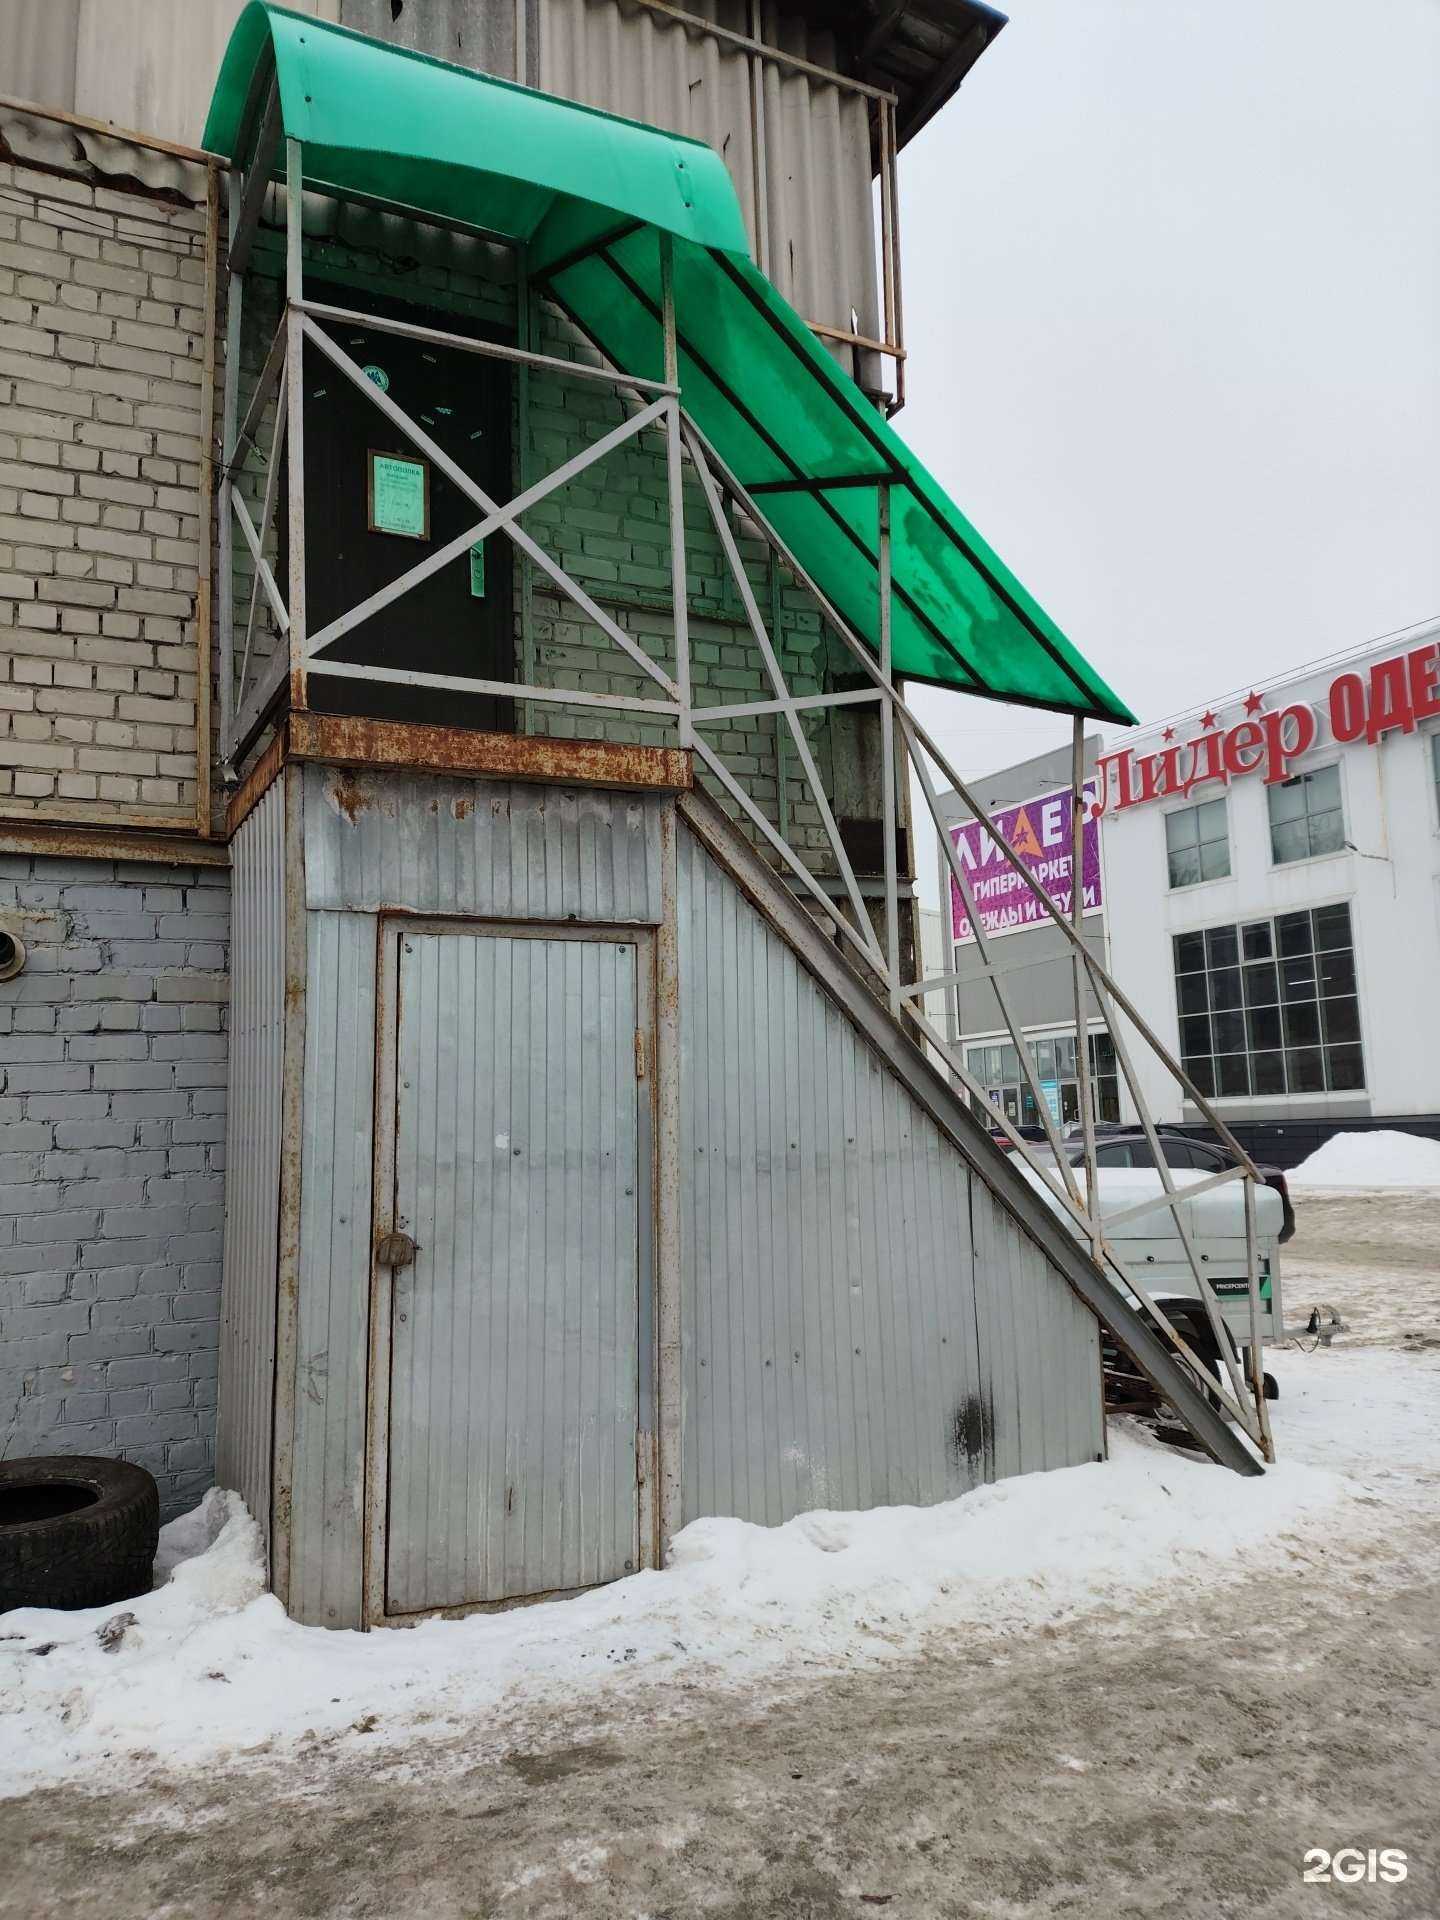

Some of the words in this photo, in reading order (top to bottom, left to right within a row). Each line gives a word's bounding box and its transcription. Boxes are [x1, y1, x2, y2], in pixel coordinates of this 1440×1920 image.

[1091, 703, 1315, 817] Лидер
[1329, 642, 1440, 745] ОДЕ
[959, 903, 1022, 937] ОЕЖДЫ
